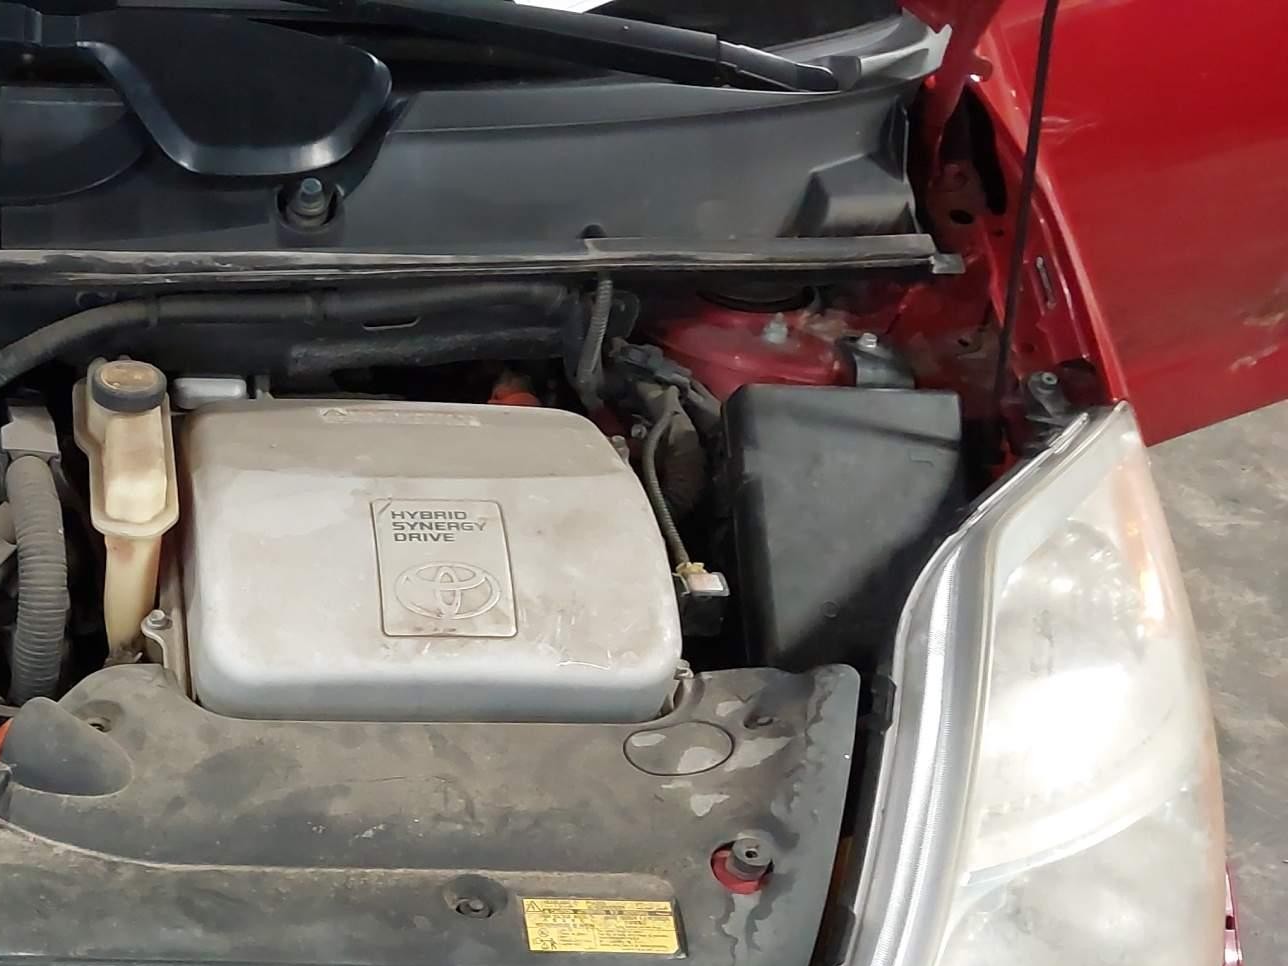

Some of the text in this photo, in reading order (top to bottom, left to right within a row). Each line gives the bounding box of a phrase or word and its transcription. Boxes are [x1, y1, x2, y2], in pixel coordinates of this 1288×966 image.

[391, 511, 467, 520] HYBRID
[392, 521, 486, 531] SYNERGY
[394, 533, 455, 542] DRIVE
